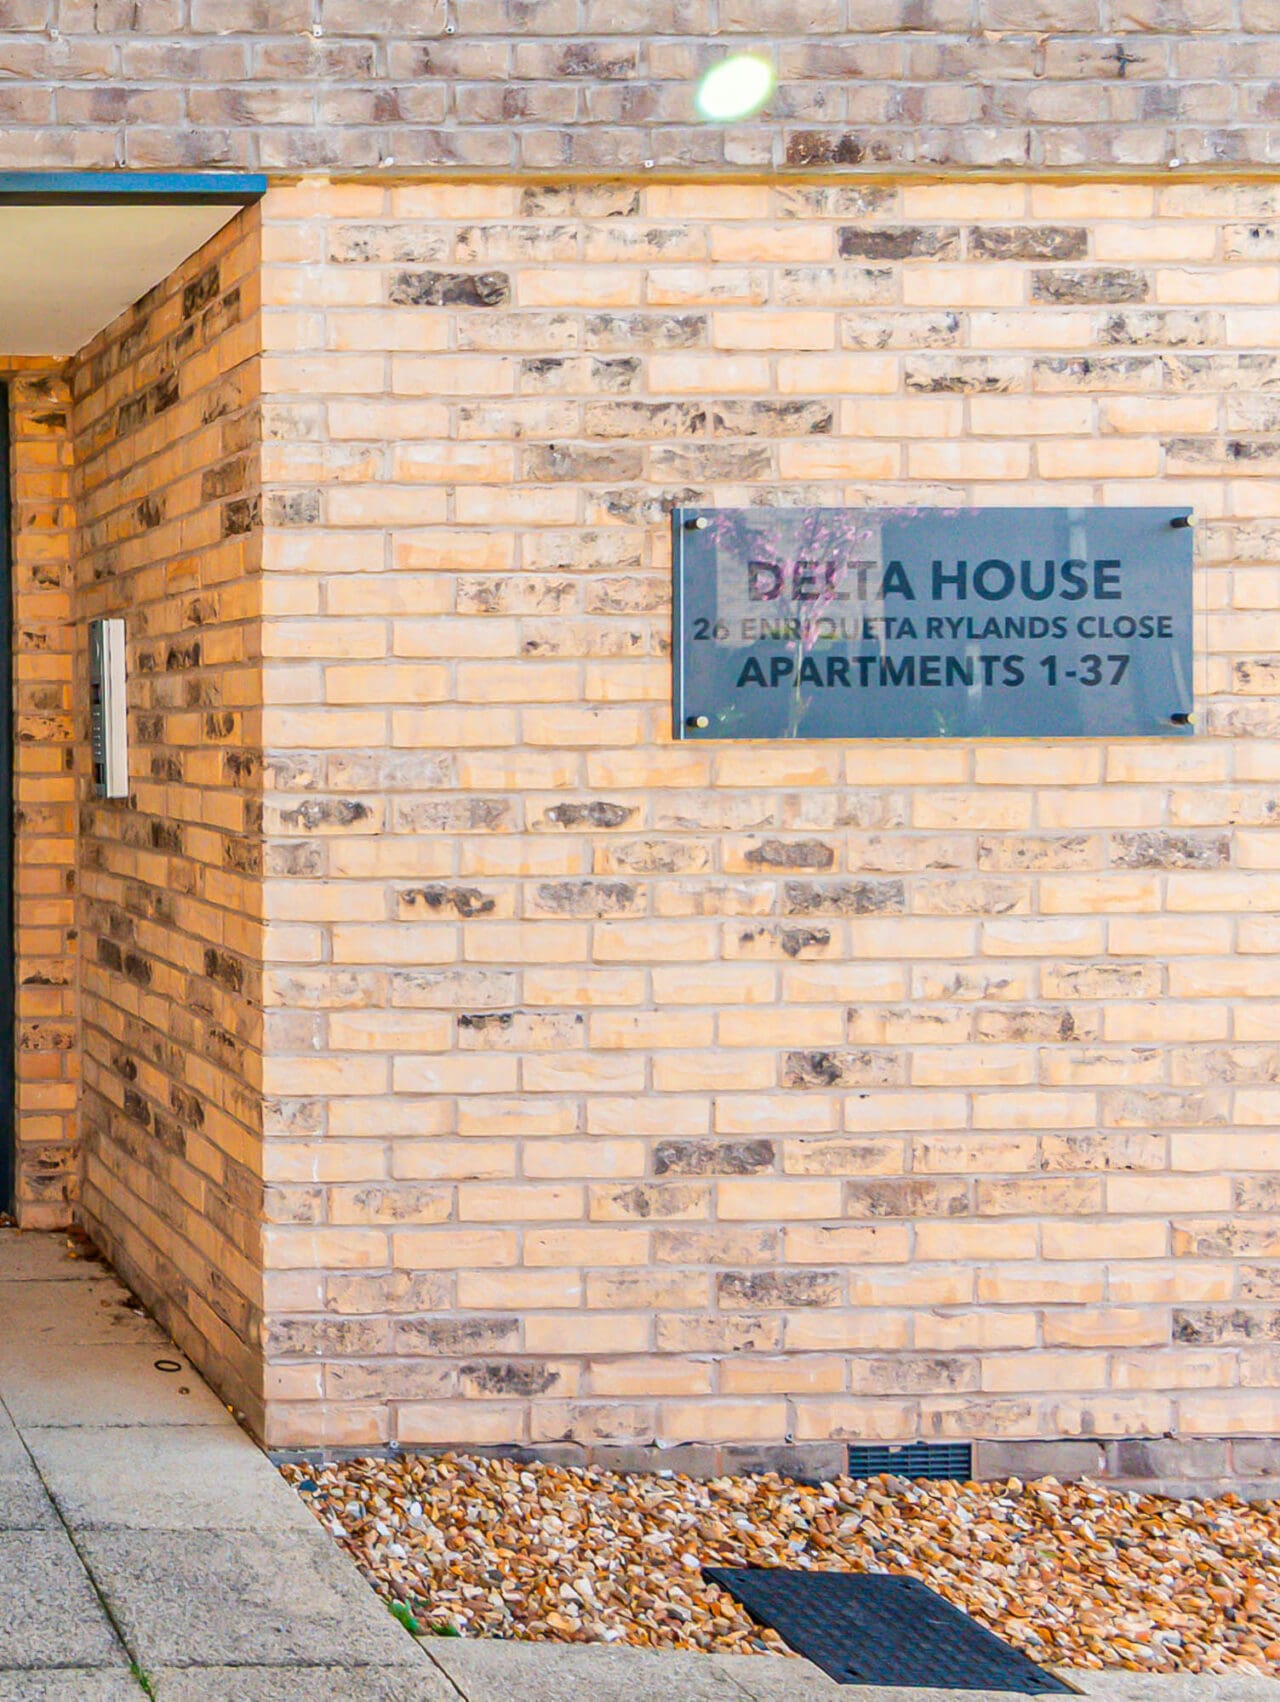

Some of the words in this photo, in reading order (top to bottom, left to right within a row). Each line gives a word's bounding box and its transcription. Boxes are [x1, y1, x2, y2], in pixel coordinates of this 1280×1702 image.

[747, 560, 916, 601] DELTA
[931, 558, 1122, 601] HOUSE
[693, 617, 730, 641] 26
[741, 616, 918, 641] ENRIQUETA
[926, 615, 1068, 640] RYLANDS
[1076, 615, 1174, 640] CLOSE
[735, 653, 1025, 688] APARTMENTS
[1038, 653, 1131, 687] 1-37
